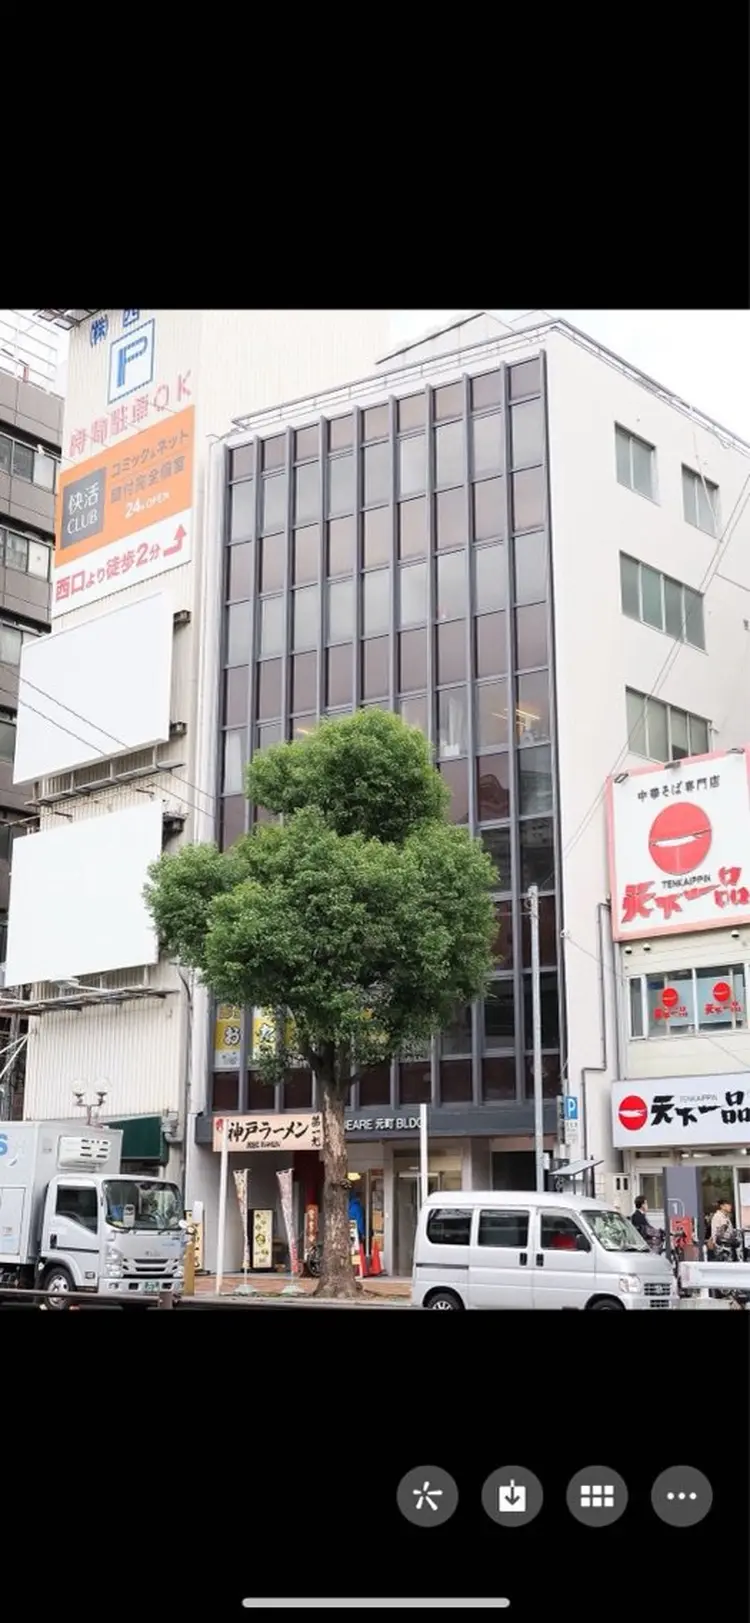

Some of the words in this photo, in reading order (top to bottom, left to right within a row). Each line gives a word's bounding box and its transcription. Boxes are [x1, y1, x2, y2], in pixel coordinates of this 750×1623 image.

[117, 335, 148, 388] P
[68, 481, 100, 516] 快活
[66, 508, 99, 535] CLUB
[55, 542, 162, 602] 西口より徒歩2分
[637, 775, 720, 802] 中華そば専門店
[621, 866, 750, 924] 天下一品
[660, 874, 712, 890] TENKAIPPIN
[567, 1098, 576, 1118] P
[651, 1090, 750, 1127] 天下一品
[227, 1120, 309, 1142] 神戸ラーメン
[375, 1118, 395, 1130] 元町
